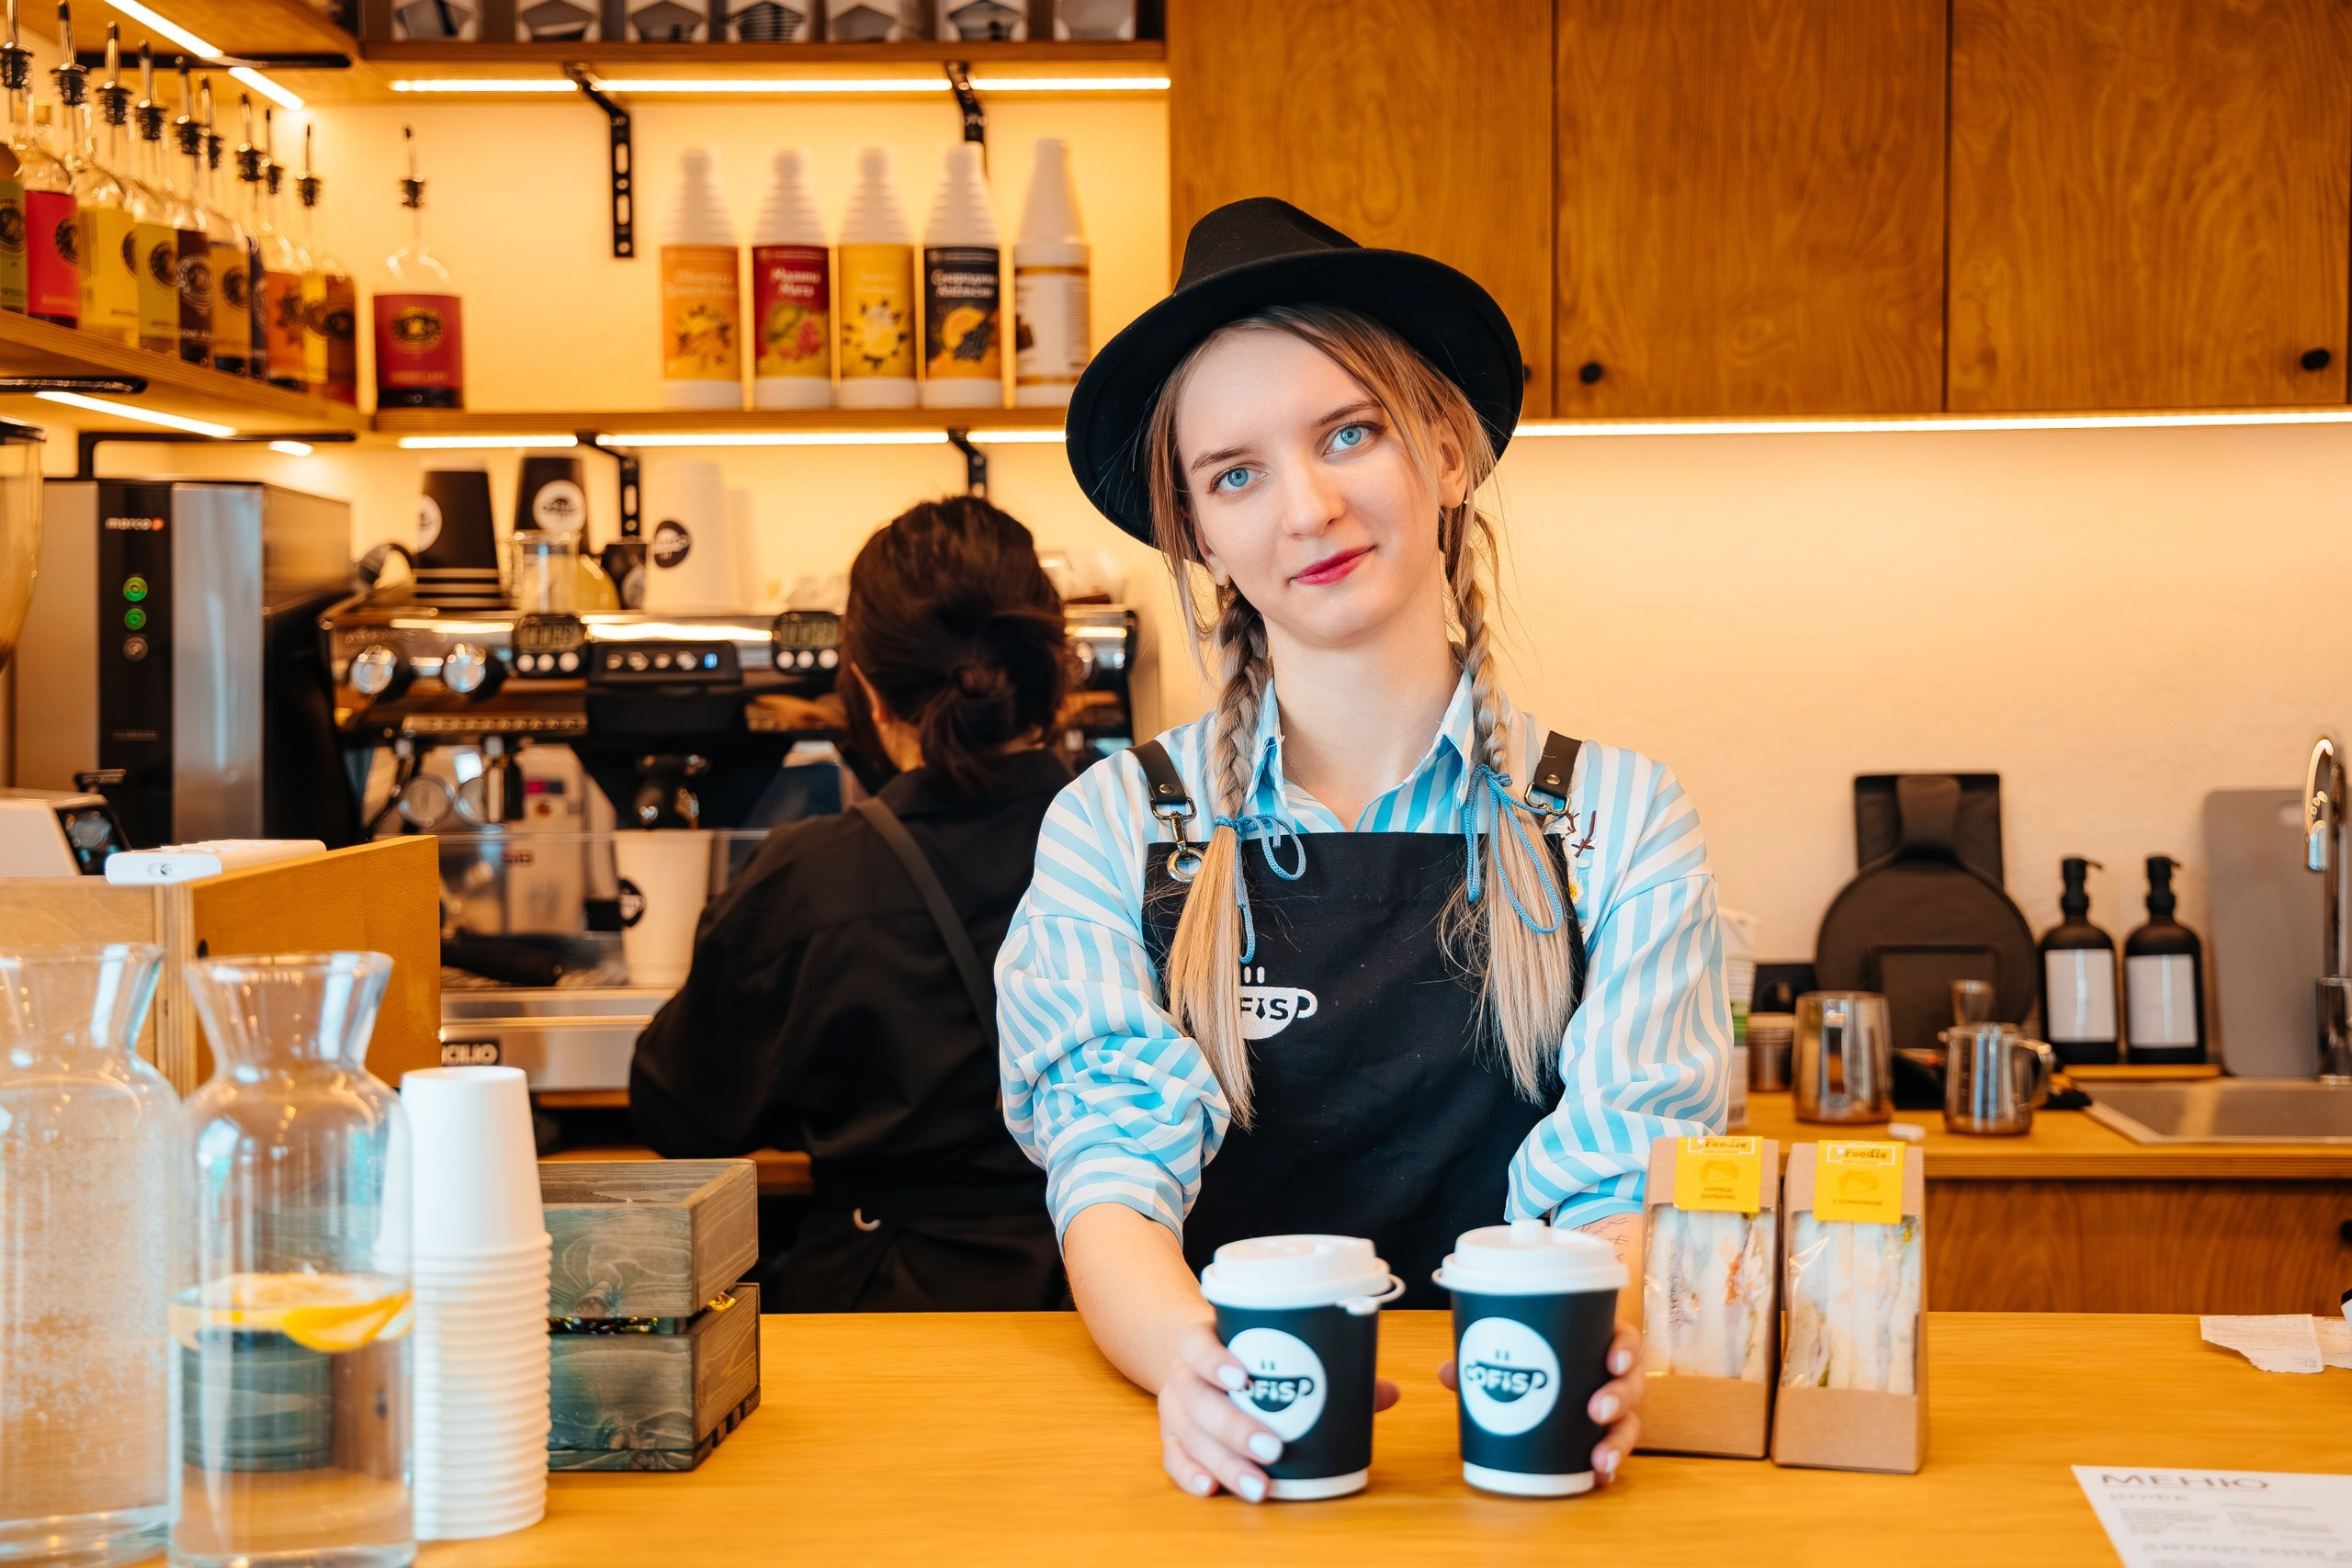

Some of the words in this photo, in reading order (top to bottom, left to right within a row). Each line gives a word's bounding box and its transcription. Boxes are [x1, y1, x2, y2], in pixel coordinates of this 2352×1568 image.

[1705, 1139, 1747, 1148] Foodie
[1845, 1148, 1887, 1158] Foodie
[2101, 1473, 2269, 1490] МЕНЮ
